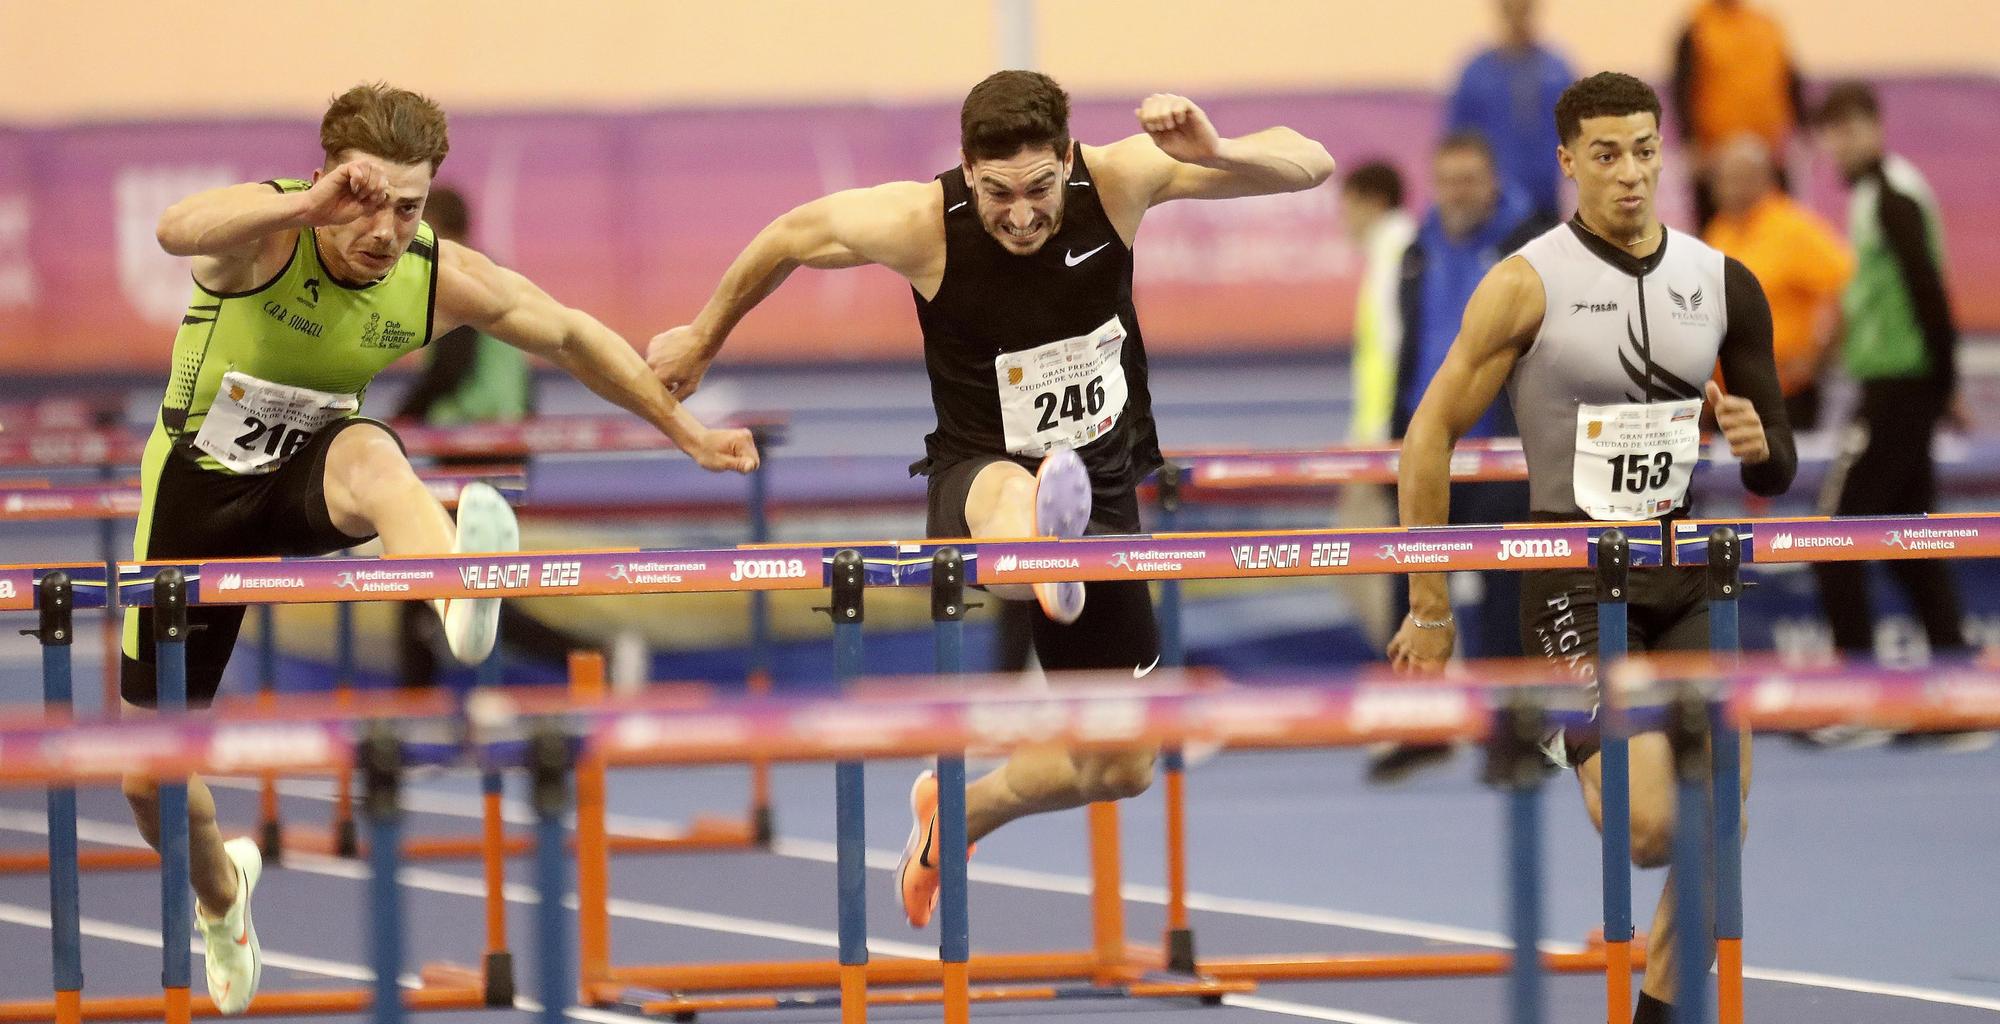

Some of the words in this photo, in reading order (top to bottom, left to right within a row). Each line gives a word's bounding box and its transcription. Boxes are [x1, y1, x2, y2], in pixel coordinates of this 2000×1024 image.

[1590, 301, 1618, 313] rasán
[385, 320, 401, 328] Club
[383, 328, 415, 337] Atletismo
[381, 335, 410, 343] SIURELL
[1042, 367, 1066, 379] GRAN
[260, 406, 283, 414] GRAN
[1034, 375, 1105, 433] 246
[234, 417, 312, 458] 216
[1644, 439, 1678, 447] VALENCIA
[1607, 451, 1673, 494] 153
[1903, 528, 1978, 538] Mediterranean
[1397, 541, 1473, 553] Mediterranean
[1794, 536, 1854, 548] IBERDROLA
[1909, 540, 1955, 550] Athletics
[1129, 550, 1206, 561] Mediterranean
[1230, 544, 1301, 569] VALENCIA
[1309, 542, 1351, 567] 2023
[1403, 553, 1449, 564] Athletics
[628, 561, 706, 573] Mediterranean
[1018, 558, 1079, 570] IBERDROLA
[1135, 561, 1182, 572] Athletics
[355, 569, 434, 582] Mediterranean
[459, 564, 530, 590] VALENCIA
[540, 562, 582, 588] 2023
[635, 573, 682, 585] Athletics
[242, 576, 305, 589] IBERDROLA
[362, 580, 410, 593] Athletics
